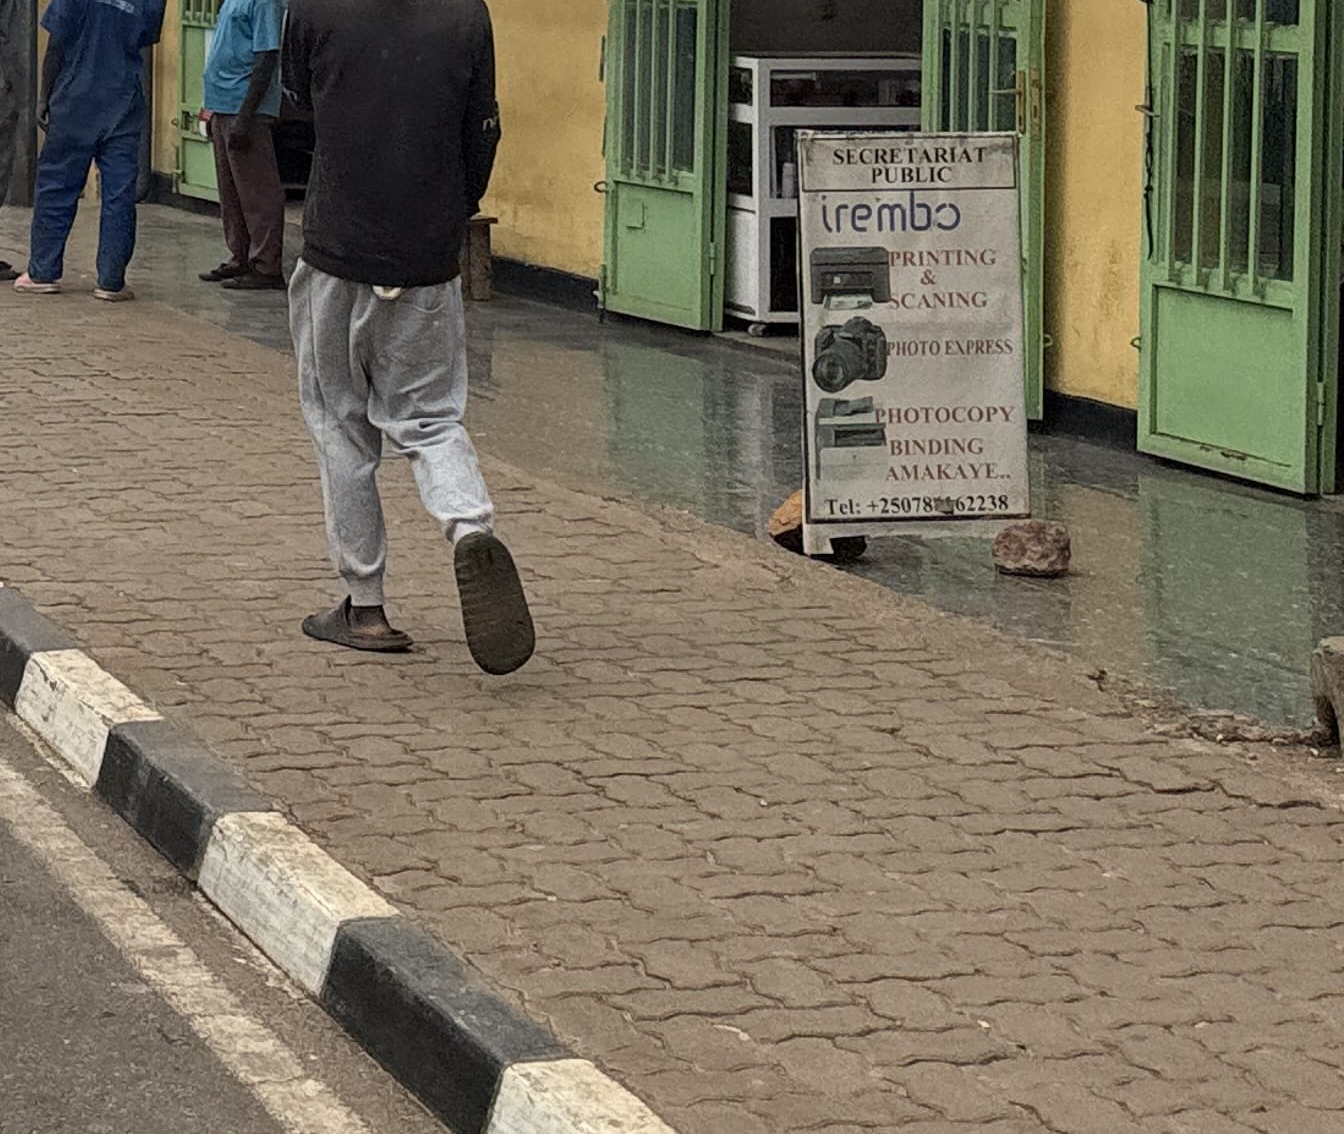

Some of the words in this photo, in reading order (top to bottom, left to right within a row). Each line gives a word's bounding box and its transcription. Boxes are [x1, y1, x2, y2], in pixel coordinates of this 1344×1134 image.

[832, 146, 987, 165] SECRETARIAT
[871, 166, 953, 184] PUBLIC
[890, 248, 997, 267] PRINTING
[920, 268, 937, 285] &
[889, 291, 988, 310] SCANING
[887, 340, 940, 357] PHOTO
[944, 338, 1013, 355] EXPRESS
[875, 405, 1015, 424] PHOTOCOPY
[890, 438, 984, 456] BINDING
[825, 498, 861, 515] Tel:
[868, 494, 1009, 514] +2507862238
